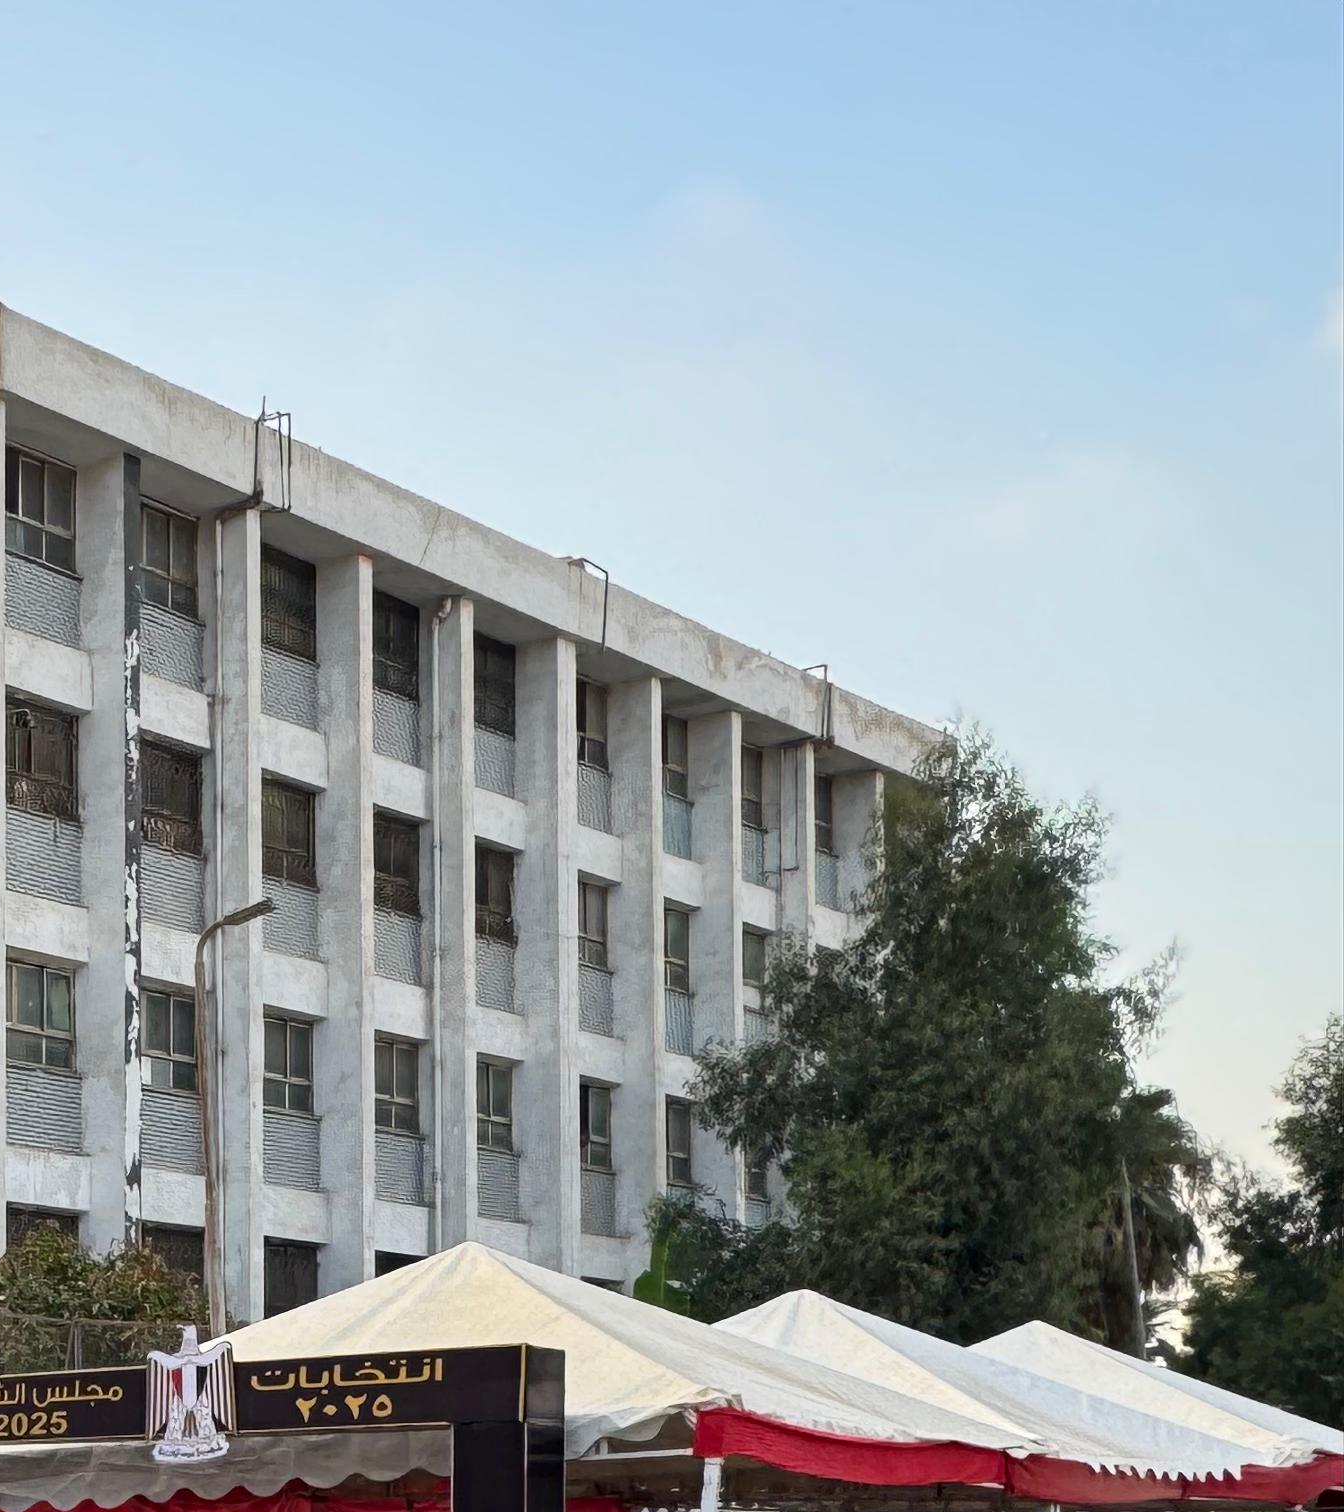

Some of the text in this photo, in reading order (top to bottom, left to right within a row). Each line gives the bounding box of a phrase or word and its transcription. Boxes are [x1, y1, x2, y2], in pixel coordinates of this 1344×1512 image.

[250, 1357, 443, 1395] انتخابات
[32, 1379, 123, 1408] مجلس
[295, 1393, 393, 1424] ٢٠٢٥
